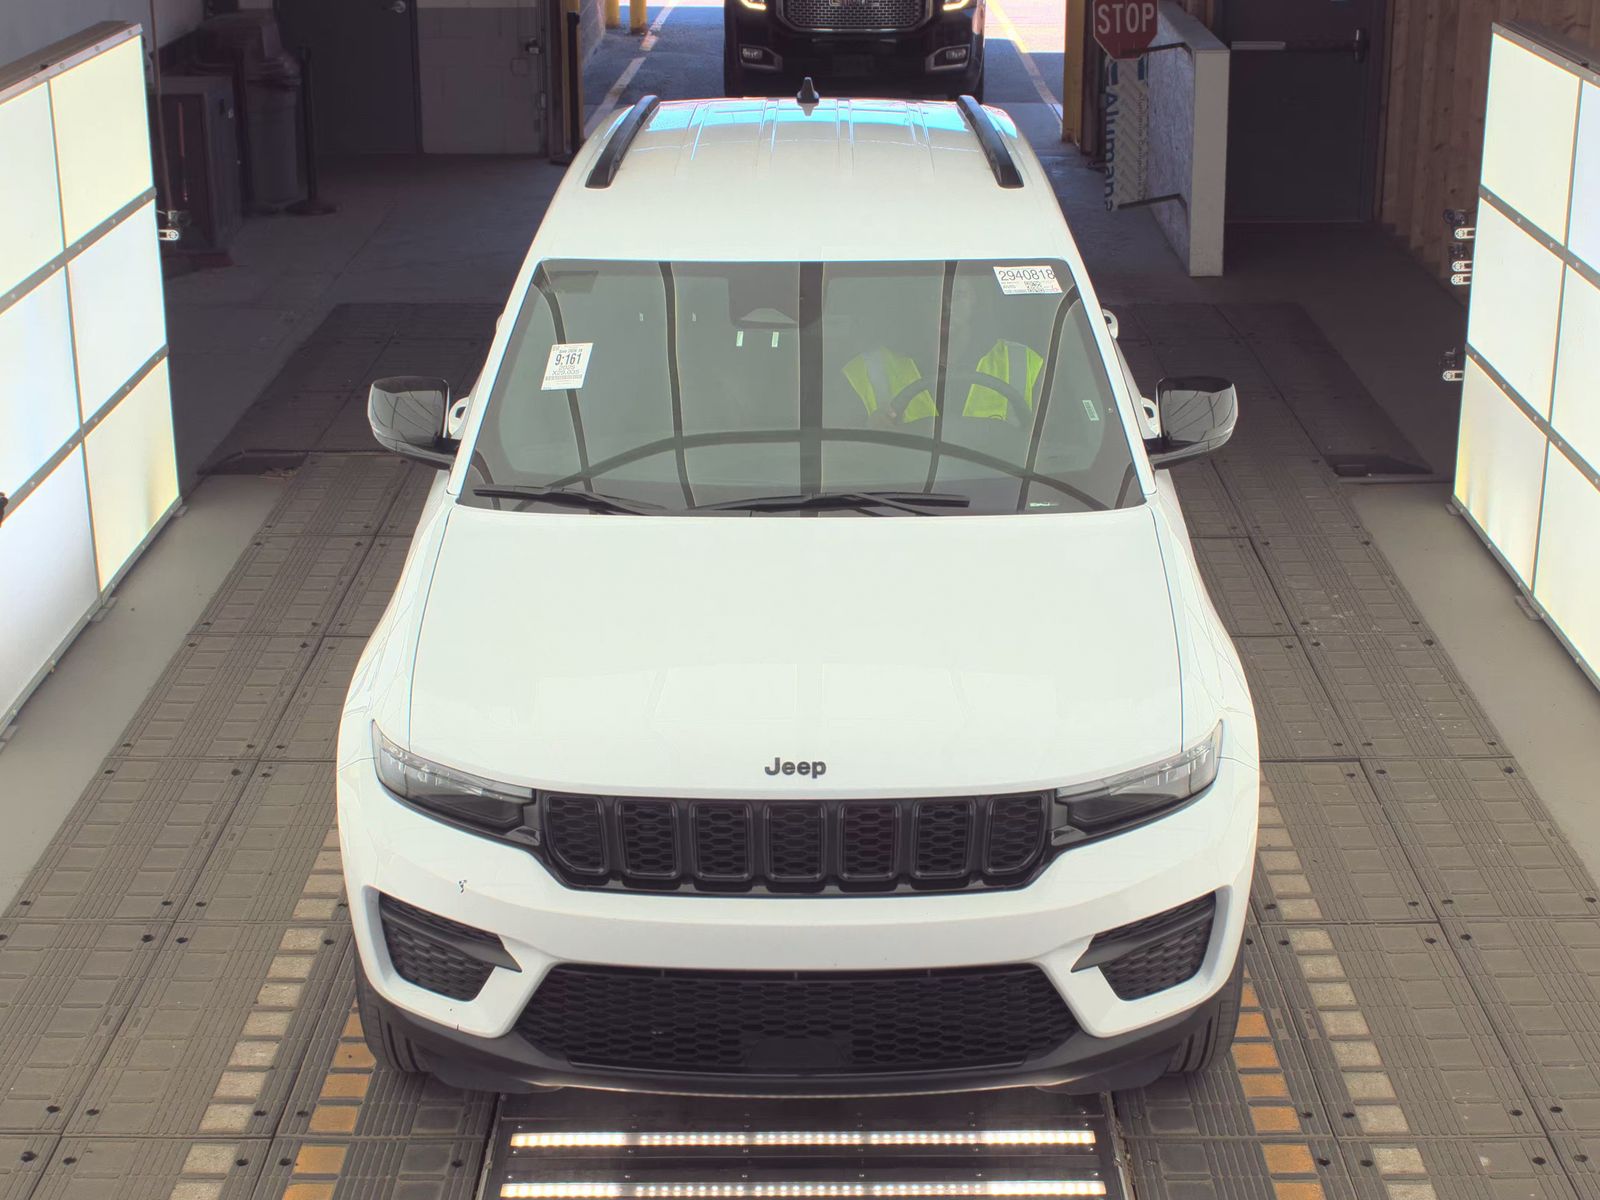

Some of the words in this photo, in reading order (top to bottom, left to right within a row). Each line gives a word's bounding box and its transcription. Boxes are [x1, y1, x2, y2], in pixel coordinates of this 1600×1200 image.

[1097, 2, 1155, 35] STOP
[998, 268, 1056, 281] 2940818
[555, 352, 582, 366] 9:161
[764, 757, 827, 779] Jeep
